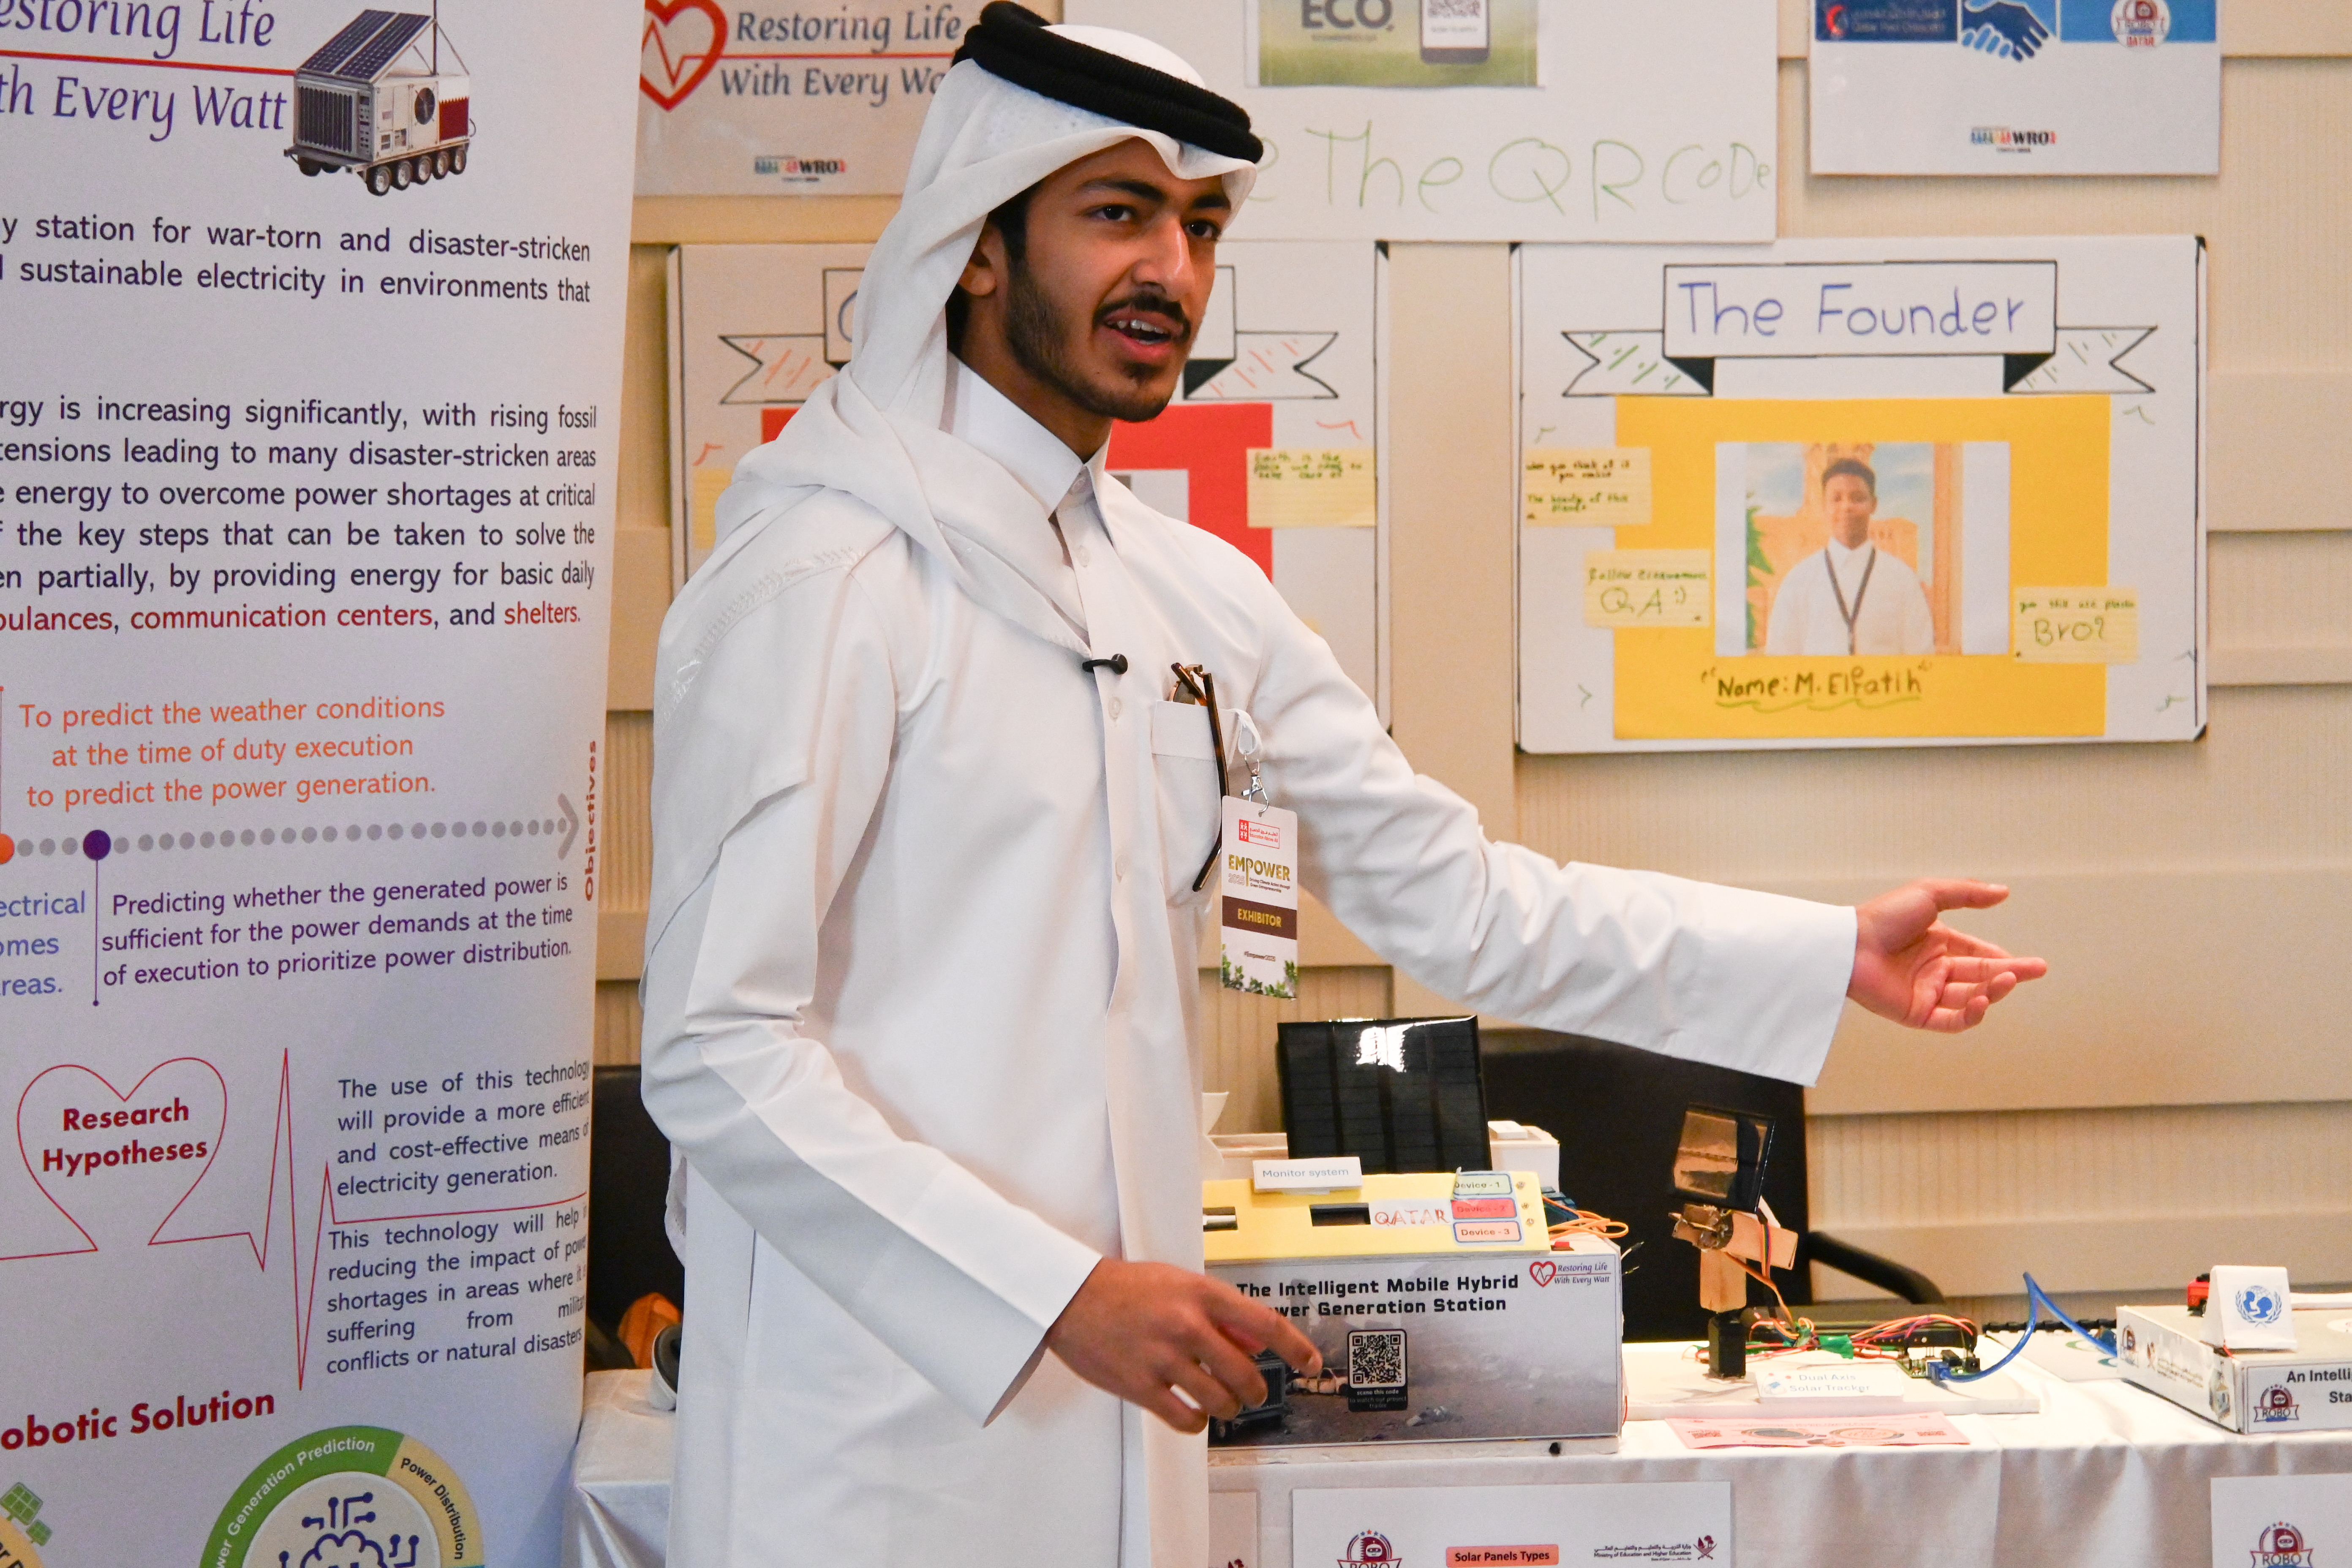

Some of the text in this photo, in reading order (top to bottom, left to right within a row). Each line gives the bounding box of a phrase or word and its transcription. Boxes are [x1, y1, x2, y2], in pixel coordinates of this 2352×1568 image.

[199, 0, 275, 47] Life
[735, 5, 962, 54] Restoring Life
[721, 63, 792, 97] With
[803, 66, 890, 107] Every
[52, 76, 175, 143] Every
[193, 85, 288, 131] Watt
[1304, 119, 1465, 214] The
[2, 213, 590, 262] y station for war-torn and disaster-stricken
[20, 257, 591, 303] sustainable electricity in environments that
[1677, 280, 2026, 338] The Founder
[0, 394, 597, 435] rgy is increasing significantly, with rising fossil
[130, 602, 326, 630] communication
[337, 604, 439, 630] centers,
[449, 601, 495, 626] and
[504, 600, 580, 625] shelters.
[19, 696, 445, 734] To predict the weather conditions
[585, 740, 596, 901] Objectives
[1228, 854, 1291, 887] EMPOWER
[0, 890, 85, 918] ectrical
[1237, 908, 1282, 928] EXHIBITOR
[2, 977, 63, 996] reas.
[338, 1078, 377, 1099] The
[391, 1079, 428, 1096] use
[441, 1072, 464, 1092] of
[476, 1070, 513, 1091] this
[63, 1097, 190, 1132] Research
[43, 1139, 208, 1178] Hypotheses
[337, 1142, 376, 1164] and
[389, 1133, 528, 1160] cost-effective
[539, 1127, 579, 1148] means
[1263, 1169, 1349, 1178] Monitor system
[328, 1229, 370, 1250] This
[384, 1220, 499, 1245] technology
[513, 1213, 544, 1234] will
[555, 1207, 579, 1229] help
[1374, 1209, 1450, 1227] QATAR
[1237, 1274, 1519, 1298] The Intelligent Mobile Hybrid
[1558, 1262, 1608, 1274] Restoring Life
[1572, 1276, 1592, 1285] Every
[327, 1289, 427, 1312] shortages
[438, 1283, 455, 1301] in
[466, 1282, 520, 1299] areas
[528, 1273, 573, 1293] where
[1271, 1297, 1506, 1317] wer Generation Station
[1827, 1384, 1870, 1392] Tracker
[2287, 1370, 2306, 1383] An
[0, 1389, 275, 1451] obotic Solution
[227, 1436, 376, 1536] Generation Prediction
[400, 1457, 469, 1560] Power Distribution
[1455, 1551, 1550, 1563] Solar Panels Types
[2262, 1553, 2302, 1566] ROBO
